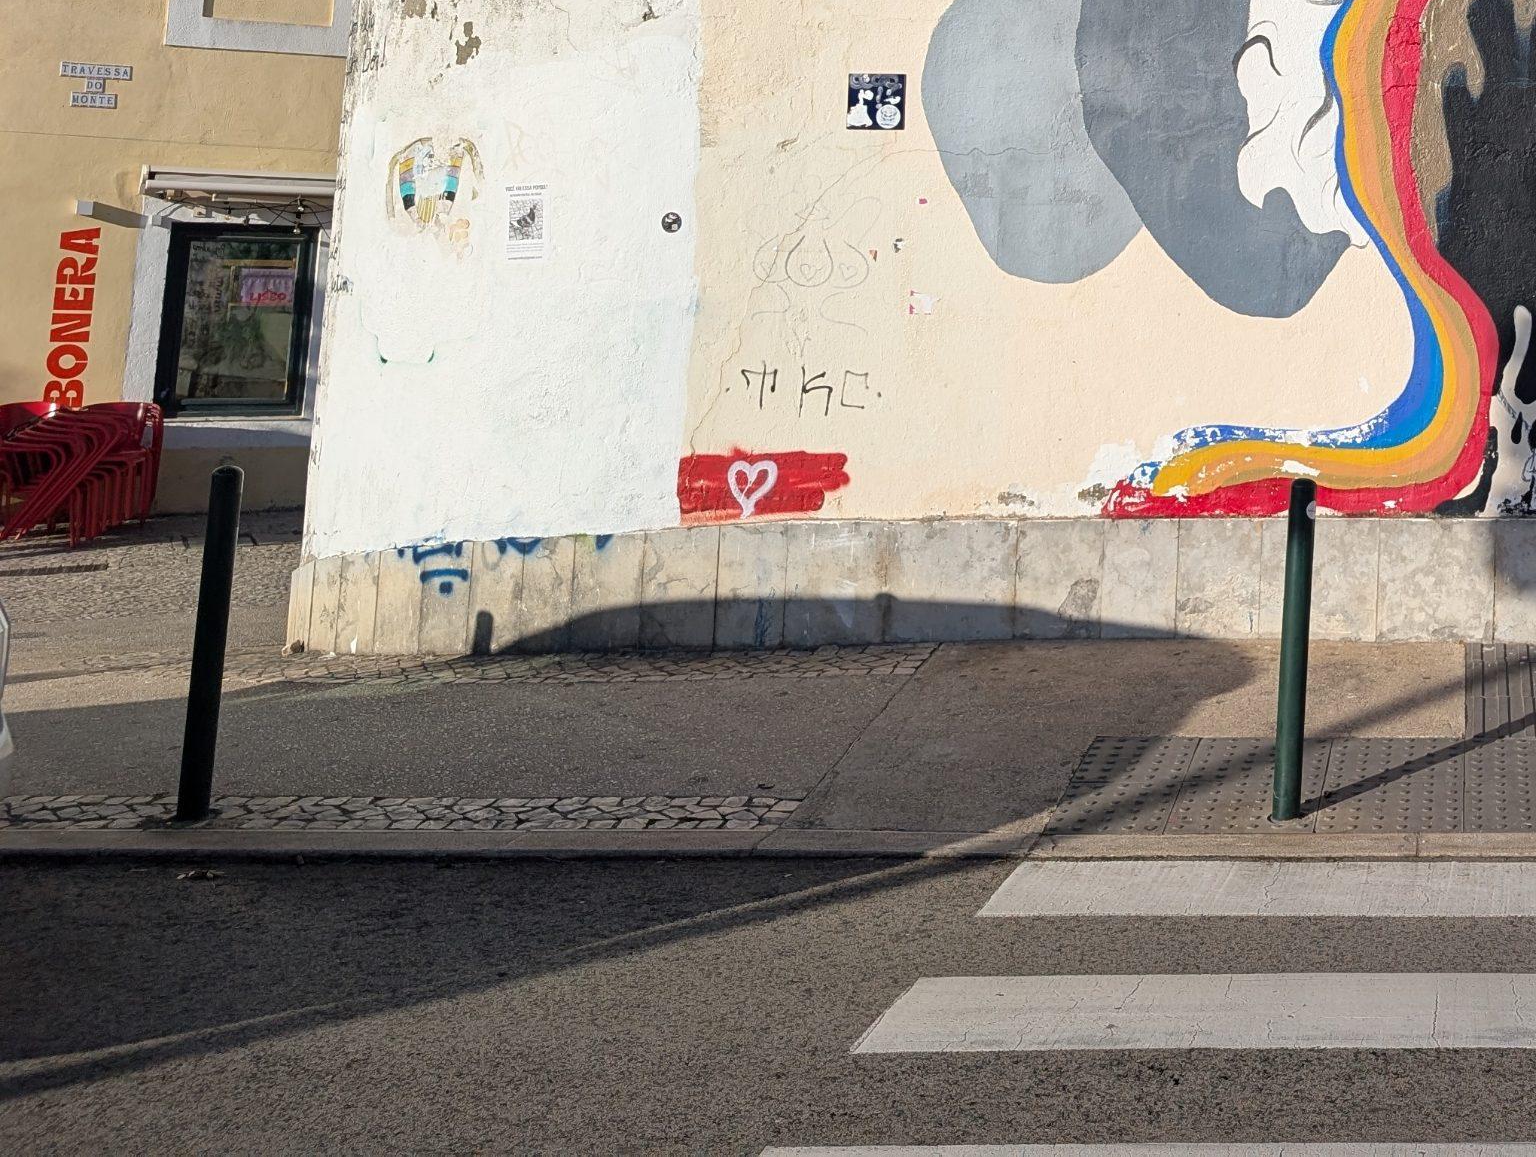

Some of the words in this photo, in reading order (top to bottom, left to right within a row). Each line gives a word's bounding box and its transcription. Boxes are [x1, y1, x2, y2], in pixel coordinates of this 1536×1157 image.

[61, 64, 129, 77] TRAVESSA
[86, 81, 103, 90] DO
[72, 95, 114, 105] MONTE
[43, 227, 102, 411] BONERA
